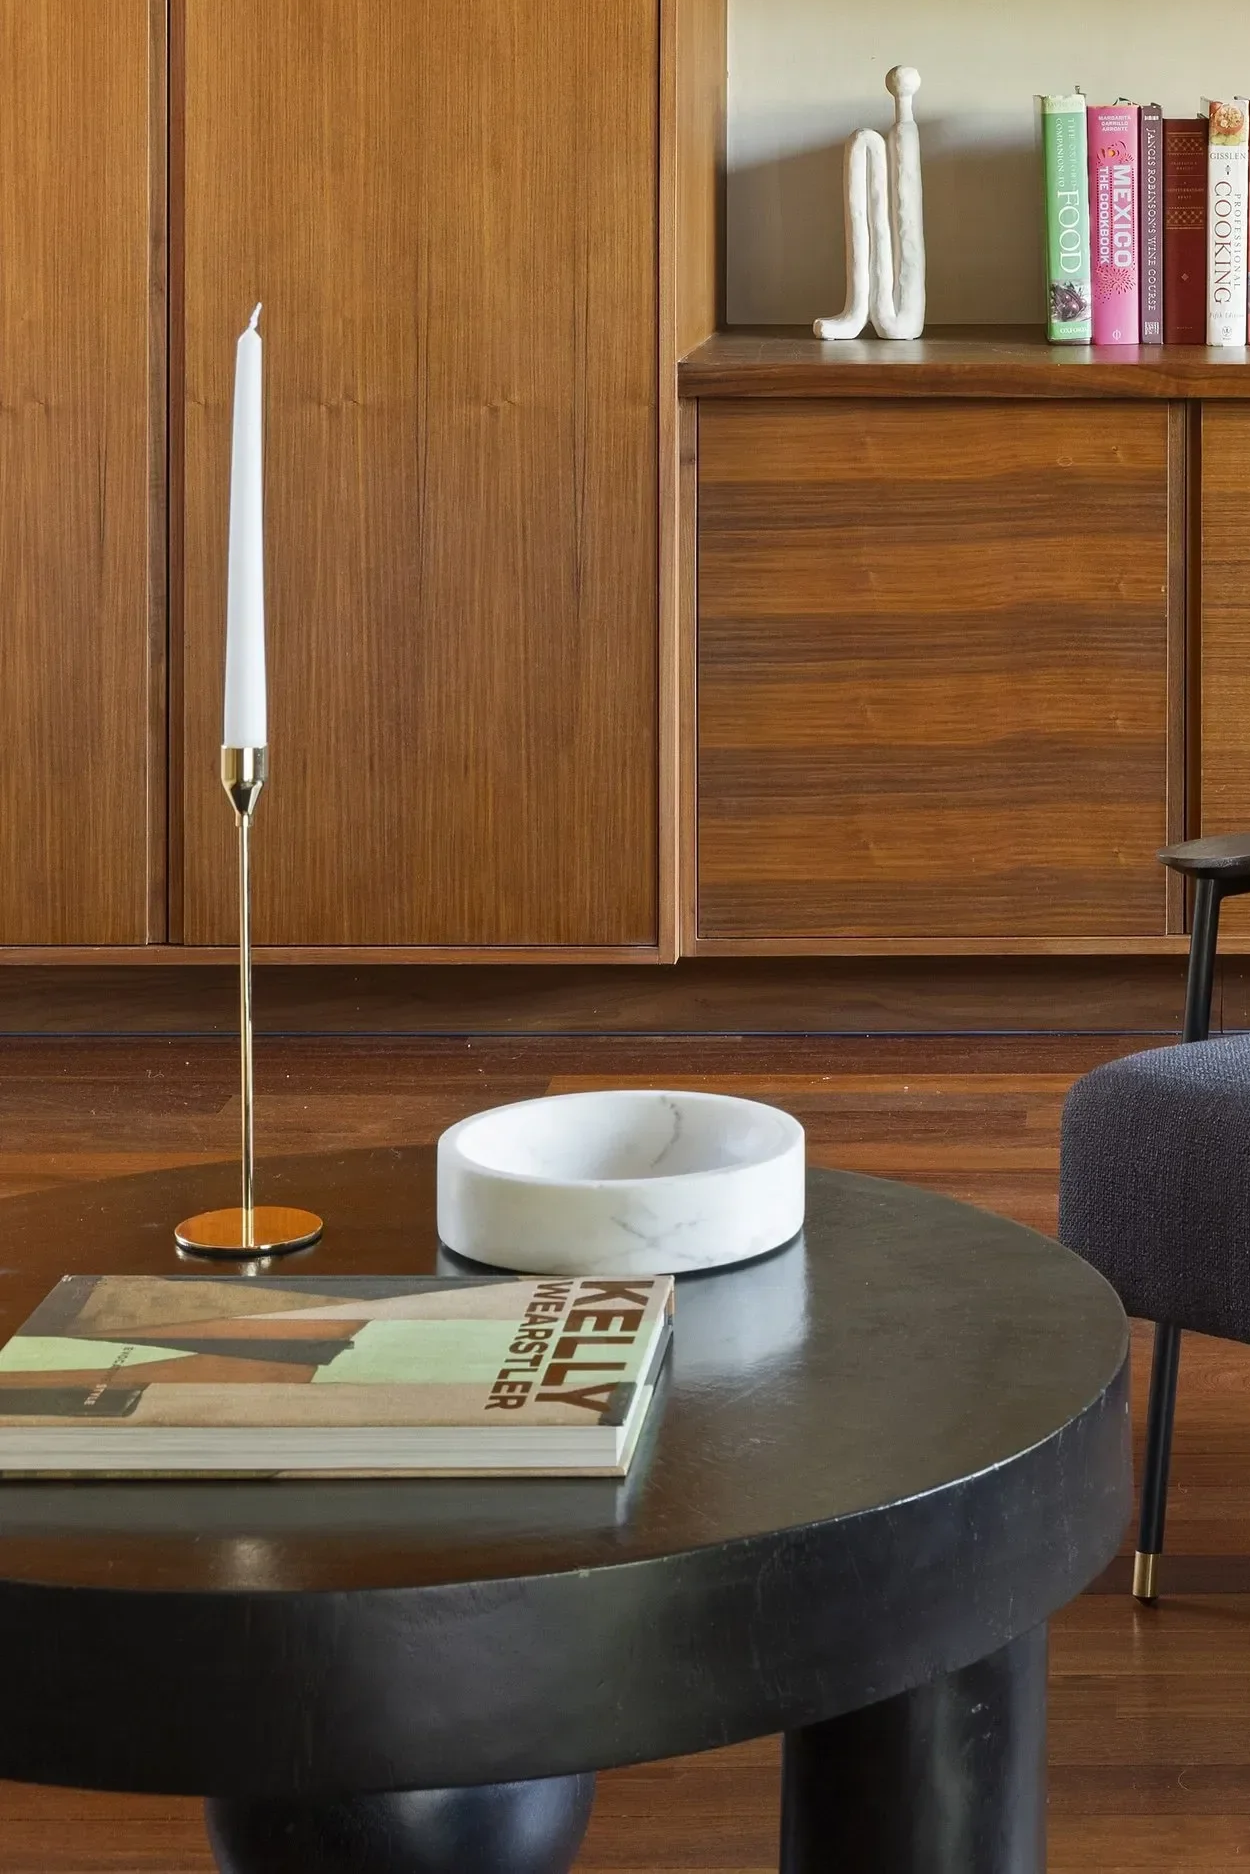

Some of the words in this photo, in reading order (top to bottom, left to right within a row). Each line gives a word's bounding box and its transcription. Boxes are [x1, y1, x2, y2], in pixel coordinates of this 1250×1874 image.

[1055, 118, 1065, 173] COMPANION
[1146, 128, 1156, 166] JANCIS
[1210, 153, 1246, 161] GISSLEN
[1057, 176, 1065, 187] TO
[1099, 167, 1109, 191] THE
[1147, 169, 1156, 233] ROBINSON'S
[1057, 190, 1082, 273] FOOD
[1100, 193, 1109, 264] COOKBOOK
[1113, 165, 1132, 268] MEXICO
[1214, 181, 1232, 304] COOKING
[1147, 236, 1156, 266] WINE
[1147, 269, 1156, 311] COURSE
[485, 1281, 573, 1410] WEARSTLER
[535, 1281, 655, 1411] KELLY
